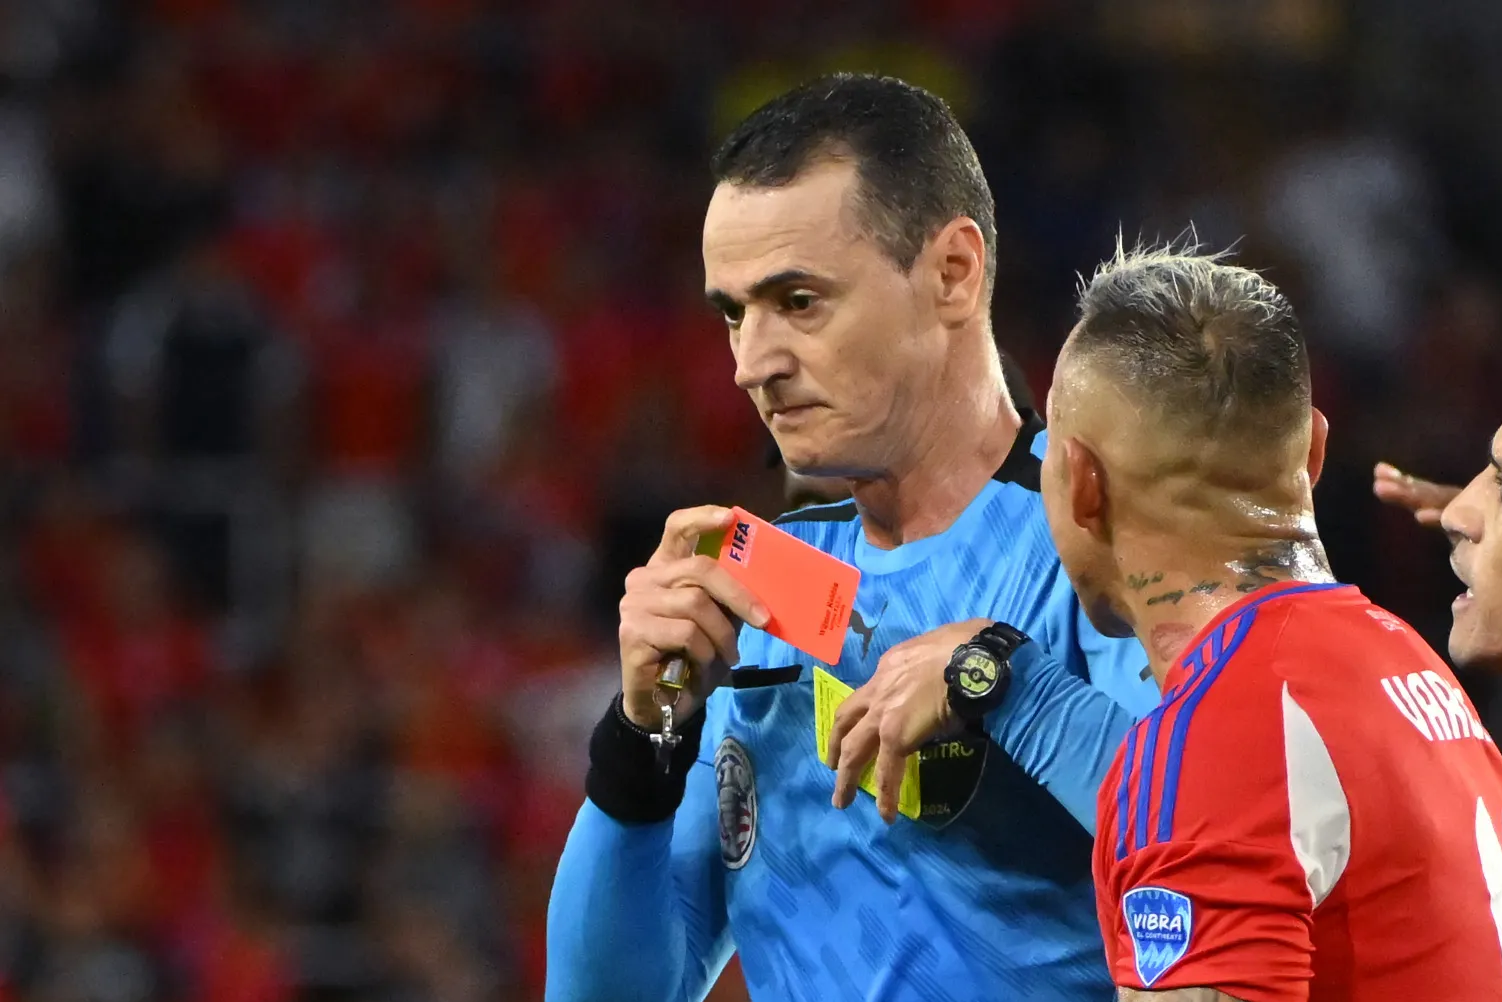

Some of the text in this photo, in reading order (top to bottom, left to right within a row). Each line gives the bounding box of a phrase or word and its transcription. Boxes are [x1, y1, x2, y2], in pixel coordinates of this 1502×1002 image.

[729, 520, 750, 563] FIFA
[1380, 669, 1492, 742] VAR
[1133, 913, 1182, 932] VIBRA
